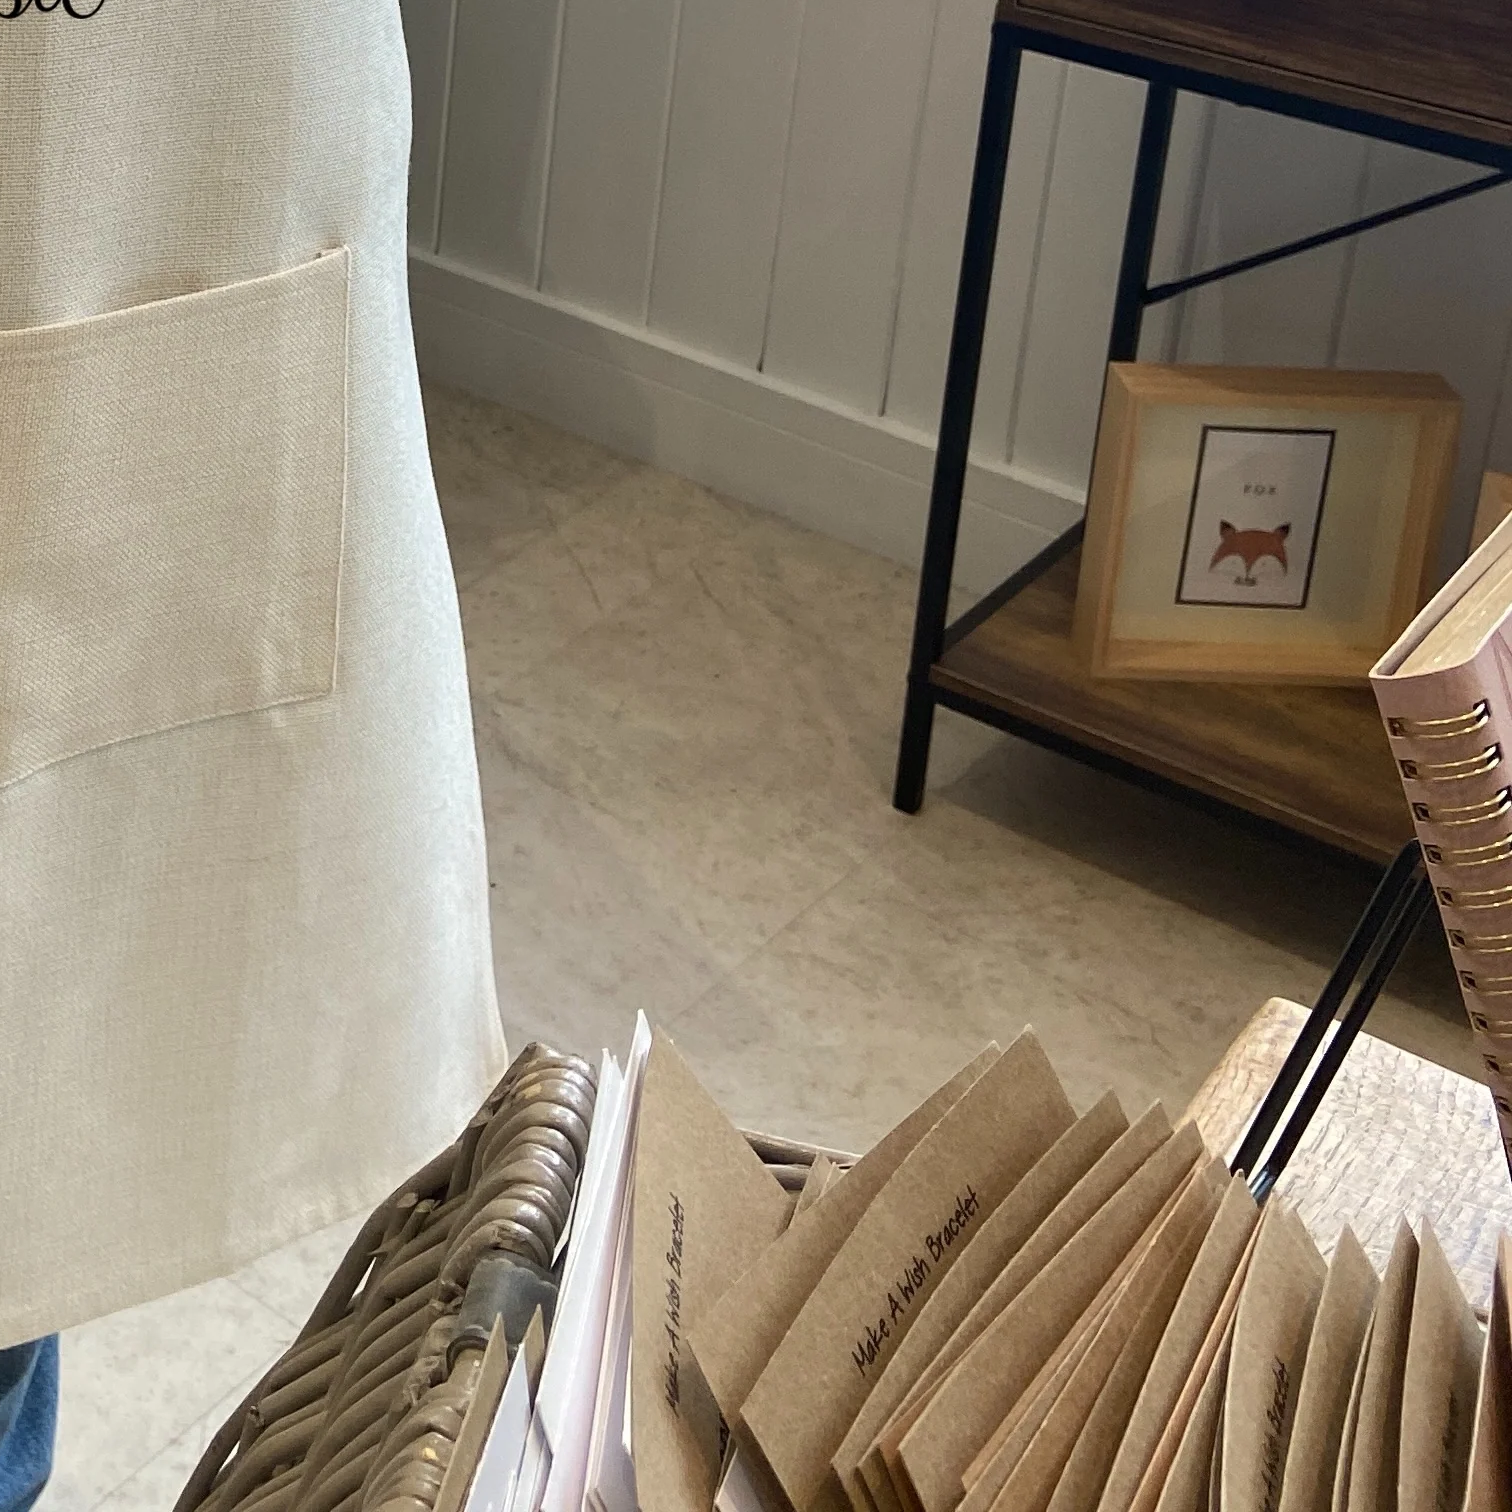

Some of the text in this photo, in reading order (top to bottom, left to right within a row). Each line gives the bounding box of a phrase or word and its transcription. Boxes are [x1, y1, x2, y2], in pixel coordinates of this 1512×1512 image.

[666, 1191, 685, 1279] Bracelet
[851, 1184, 980, 1377] Make A Wish Bracelet
[664, 1323, 681, 1355] A
